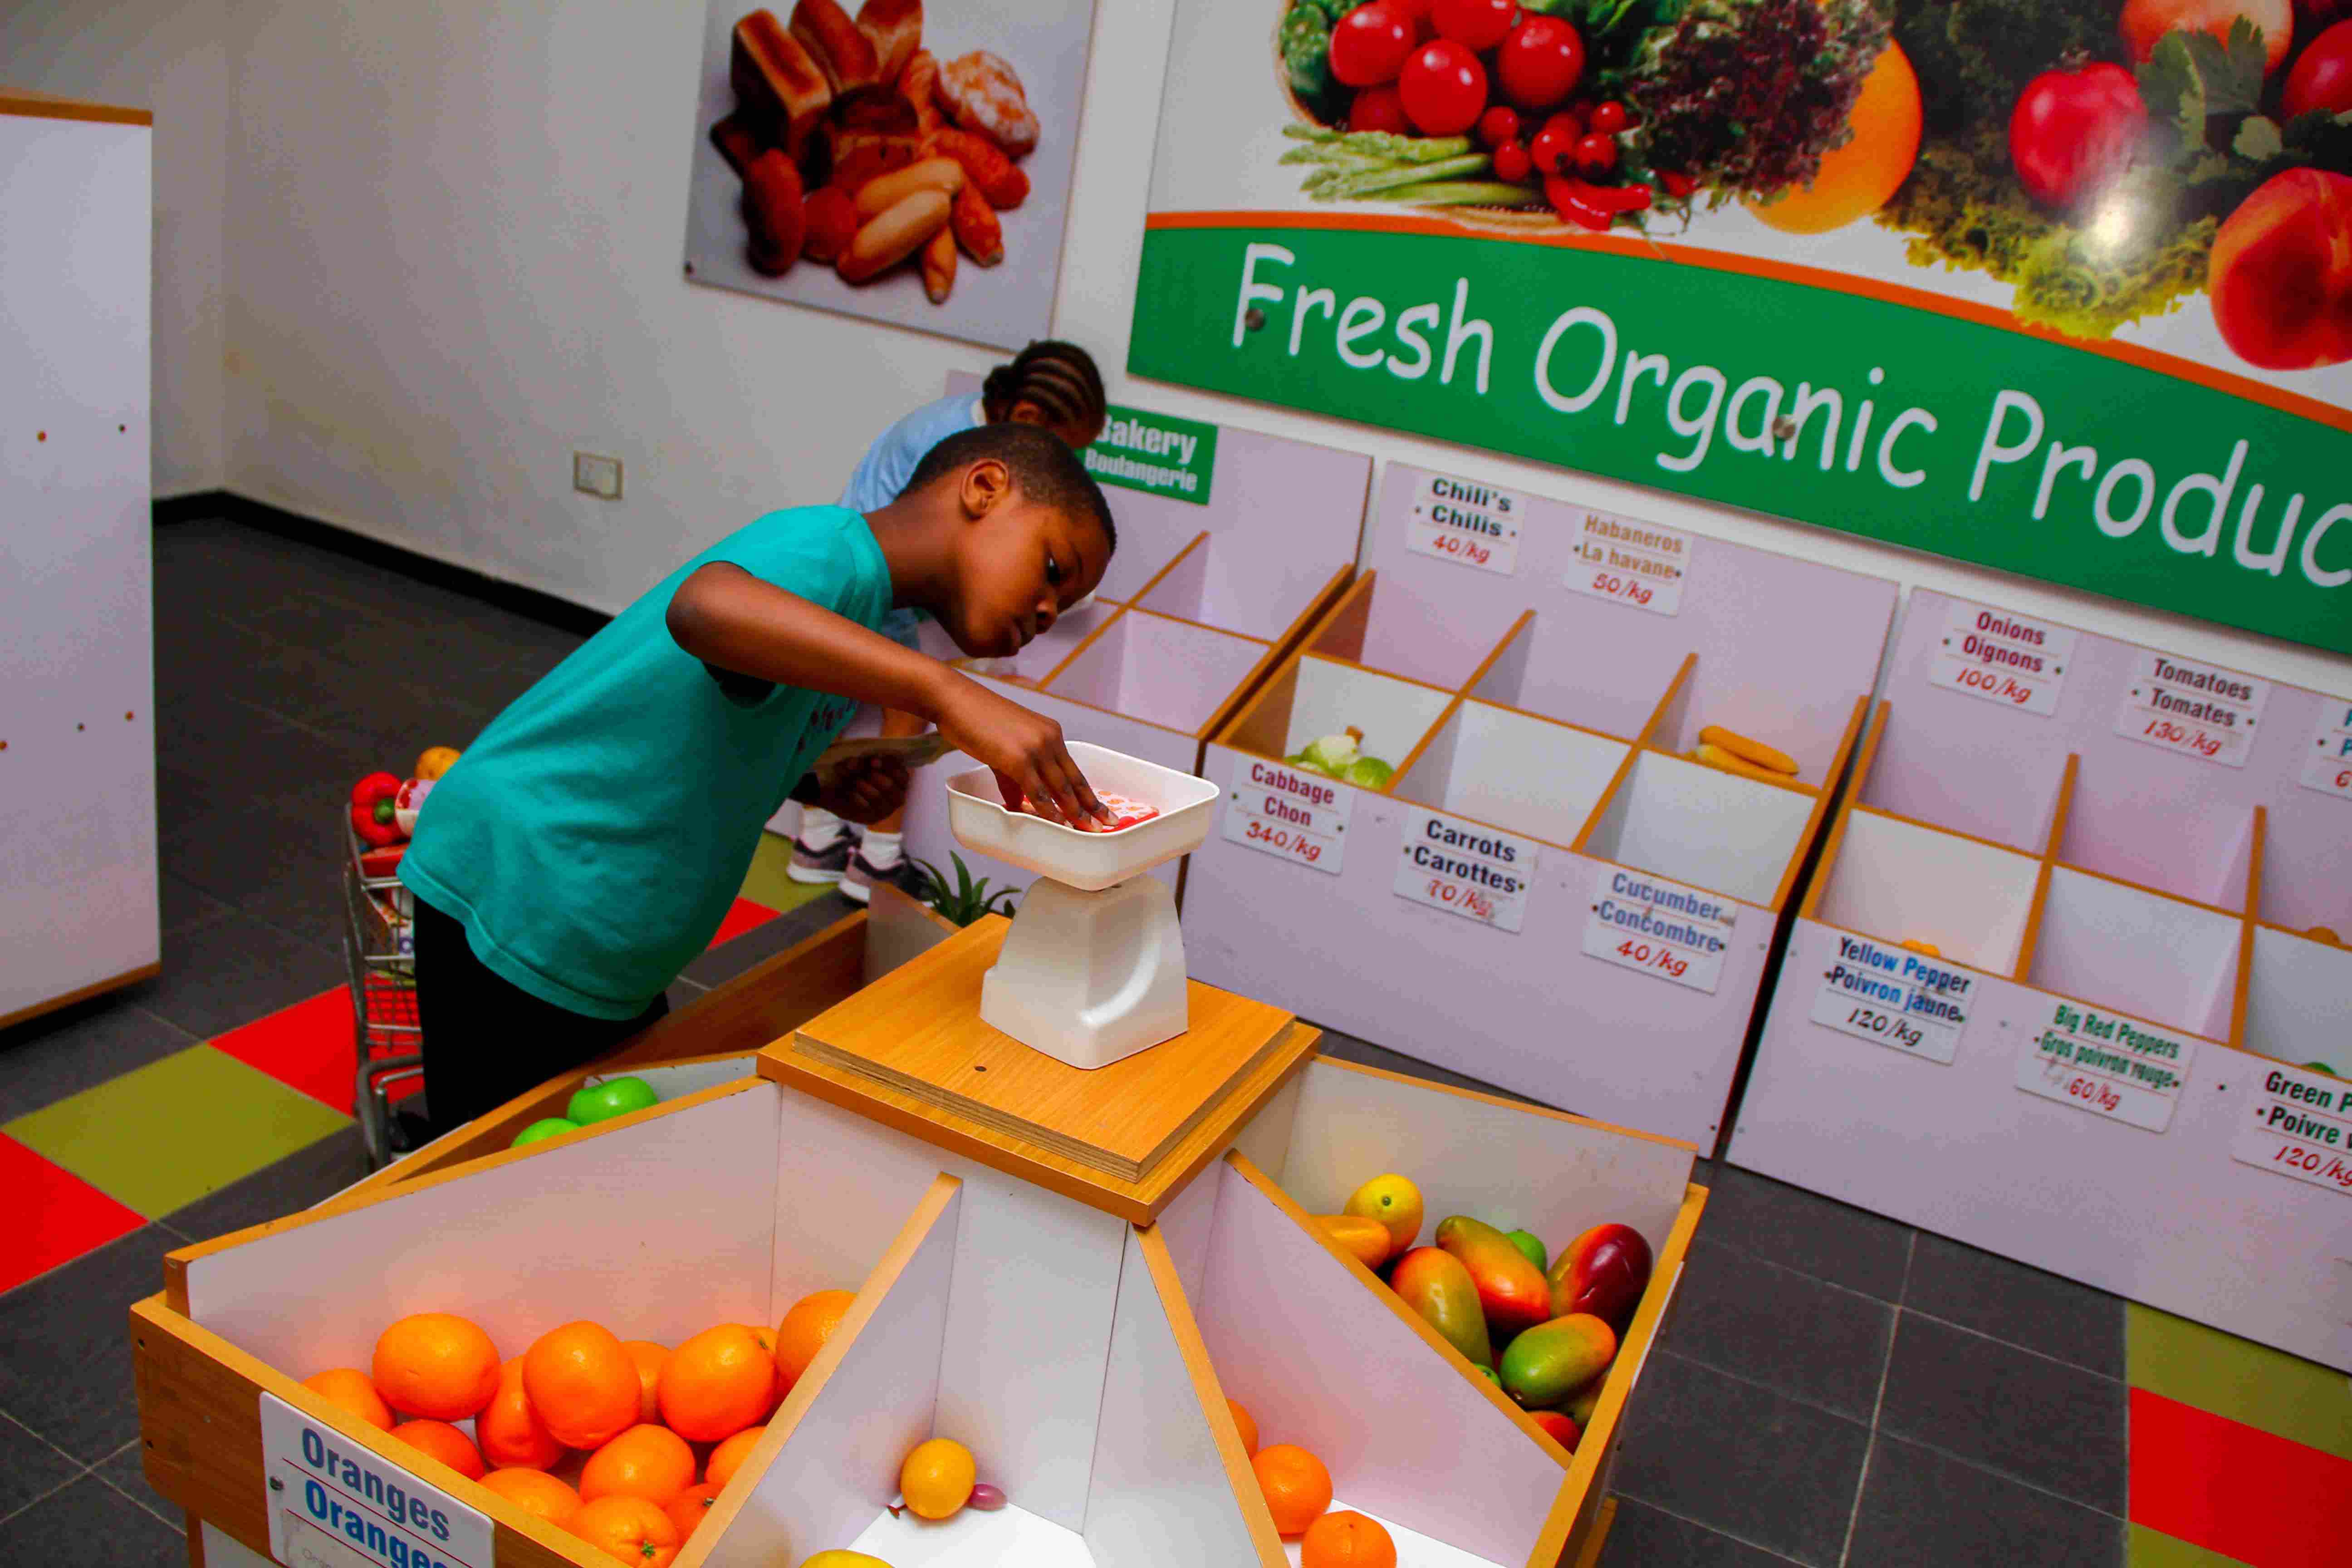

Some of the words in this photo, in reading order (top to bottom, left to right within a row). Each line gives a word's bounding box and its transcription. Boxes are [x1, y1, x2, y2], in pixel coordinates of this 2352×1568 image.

[1233, 243, 1494, 394] Fresh
[1534, 306, 1937, 487] Organic
[1968, 389, 2352, 587] Produc
[1085, 448, 1198, 492] Boulangerie
[1432, 478, 1511, 511] Chili's
[1432, 505, 1502, 536] Chilis
[1584, 515, 1682, 553] Habaneros
[1433, 535, 1490, 564] 40/kg
[1583, 543, 1602, 562] La
[1609, 548, 1675, 579] havane
[1593, 573, 1653, 604] 50/kg
[1977, 612, 2046, 646] Onions
[1963, 635, 2044, 672] Oignons
[1956, 667, 2032, 704] 100/kg
[2154, 658, 2253, 701] Tomatoes
[2151, 687, 2237, 726] Tomates
[2145, 719, 2222, 756] 130/kg
[1252, 763, 1334, 804] Cabbage
[1264, 796, 1312, 827] Chon
[1246, 821, 1322, 861] 340/kg
[1427, 819, 1516, 862] Carrots
[1415, 846, 1517, 893] Carottes
[1612, 872, 1722, 921] Cucumber
[1600, 900, 1720, 952] Concombre
[1616, 941, 1689, 977] 40/kg
[1839, 936, 1900, 972] Yellow
[1902, 956, 1970, 995] Pepper
[1831, 965, 1902, 1003] Poivron
[1903, 987, 1961, 1021] jaune
[1847, 1008, 1923, 1047] 120/kg
[2053, 1004, 2081, 1034] Big
[2082, 1013, 2116, 1039] Red
[2116, 1022, 2179, 1059] Peppers
[2265, 1070, 2333, 1108] Green
[2267, 1105, 2341, 1144] Poivre
[302, 1427, 451, 1542] Oranges
[305, 1479, 448, 1568] Orange
